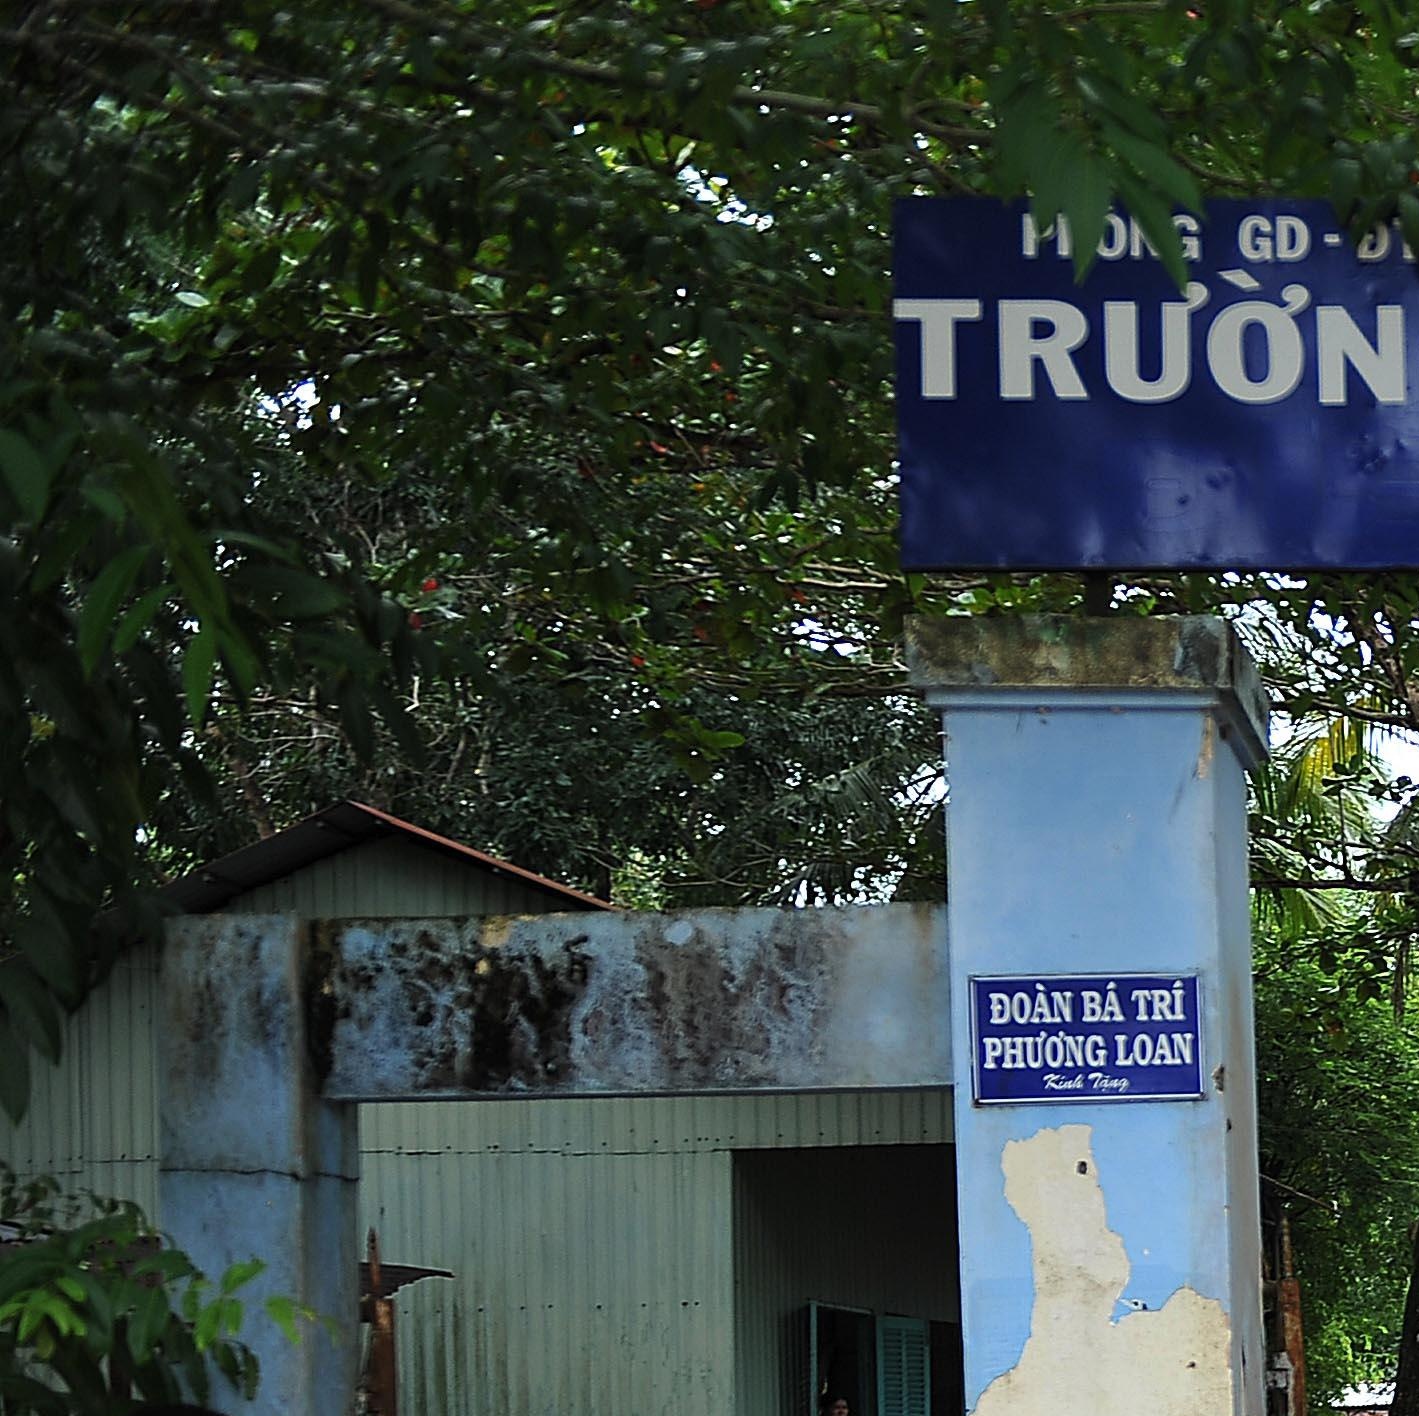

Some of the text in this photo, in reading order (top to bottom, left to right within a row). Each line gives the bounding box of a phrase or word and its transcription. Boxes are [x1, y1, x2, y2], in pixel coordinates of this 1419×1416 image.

[989, 982, 1073, 1024] ĐOÀN
[1131, 979, 1186, 1021] TRÍ
[982, 1030, 1194, 1069] PHƯƠNG LOAN
[1043, 1072, 1130, 1092] Kính Tặng
